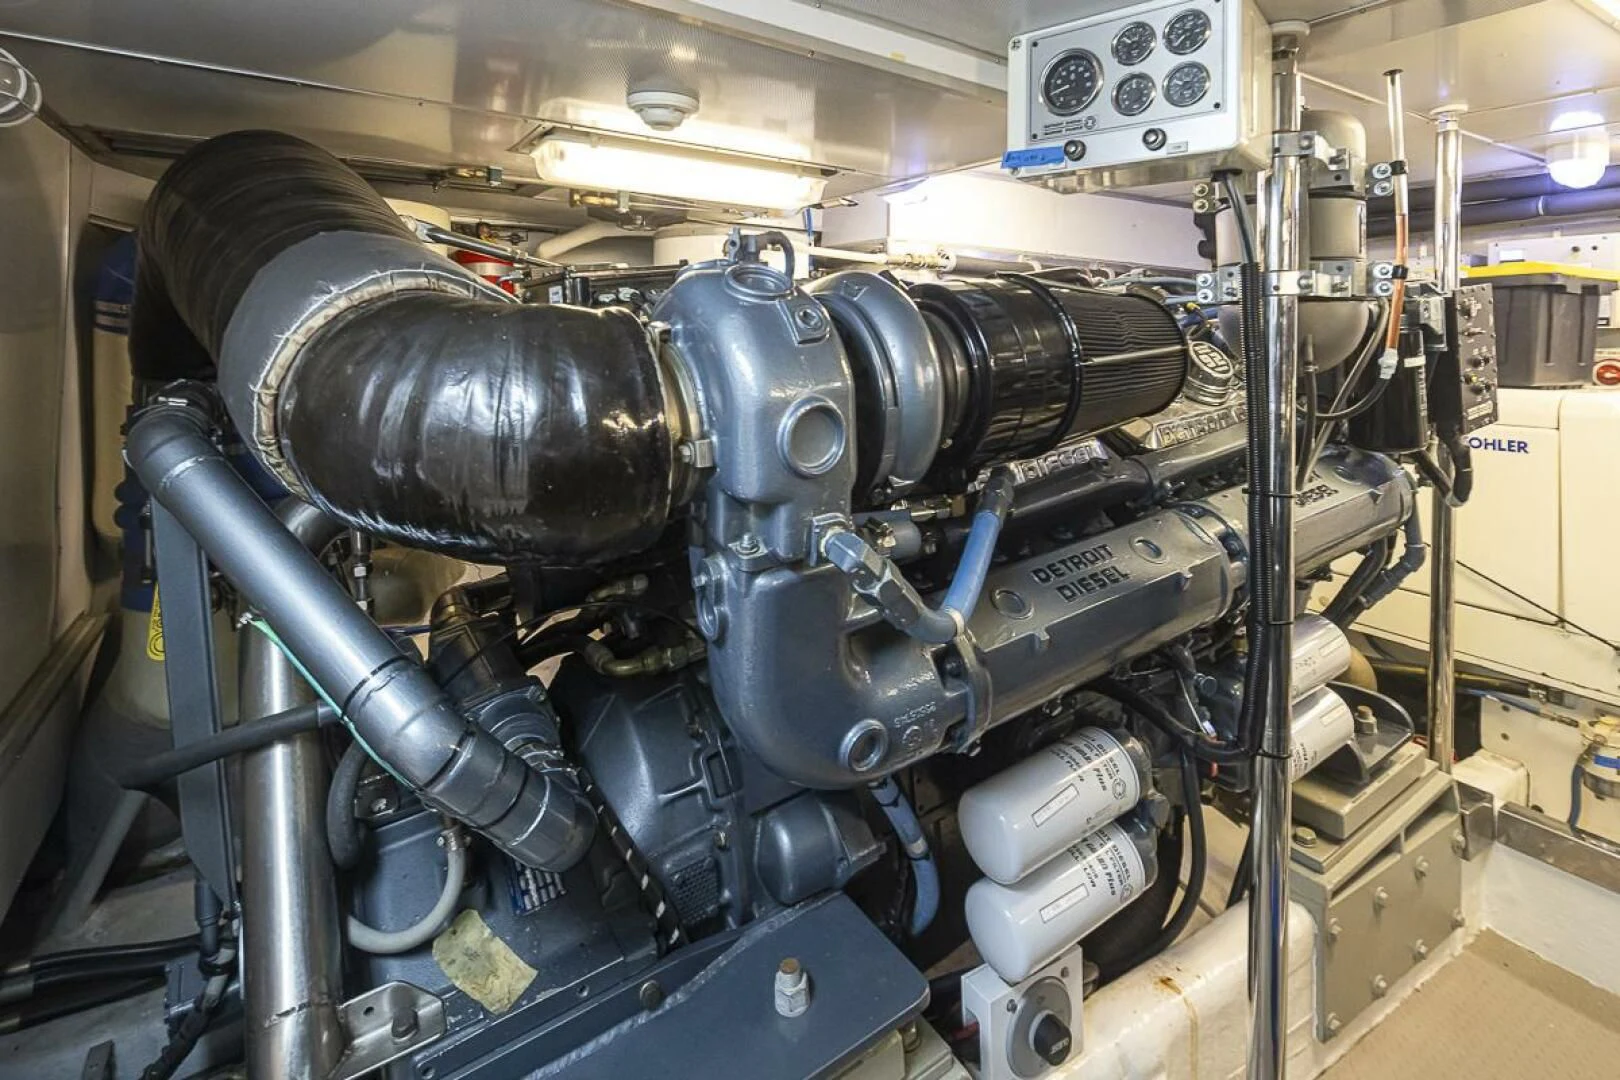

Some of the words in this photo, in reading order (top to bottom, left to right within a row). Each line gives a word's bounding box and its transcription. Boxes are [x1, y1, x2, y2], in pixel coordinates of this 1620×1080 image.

[1468, 436, 1529, 454] OHLER
[1031, 543, 1113, 584] DETROIT
[1056, 565, 1129, 602] DIESEL
